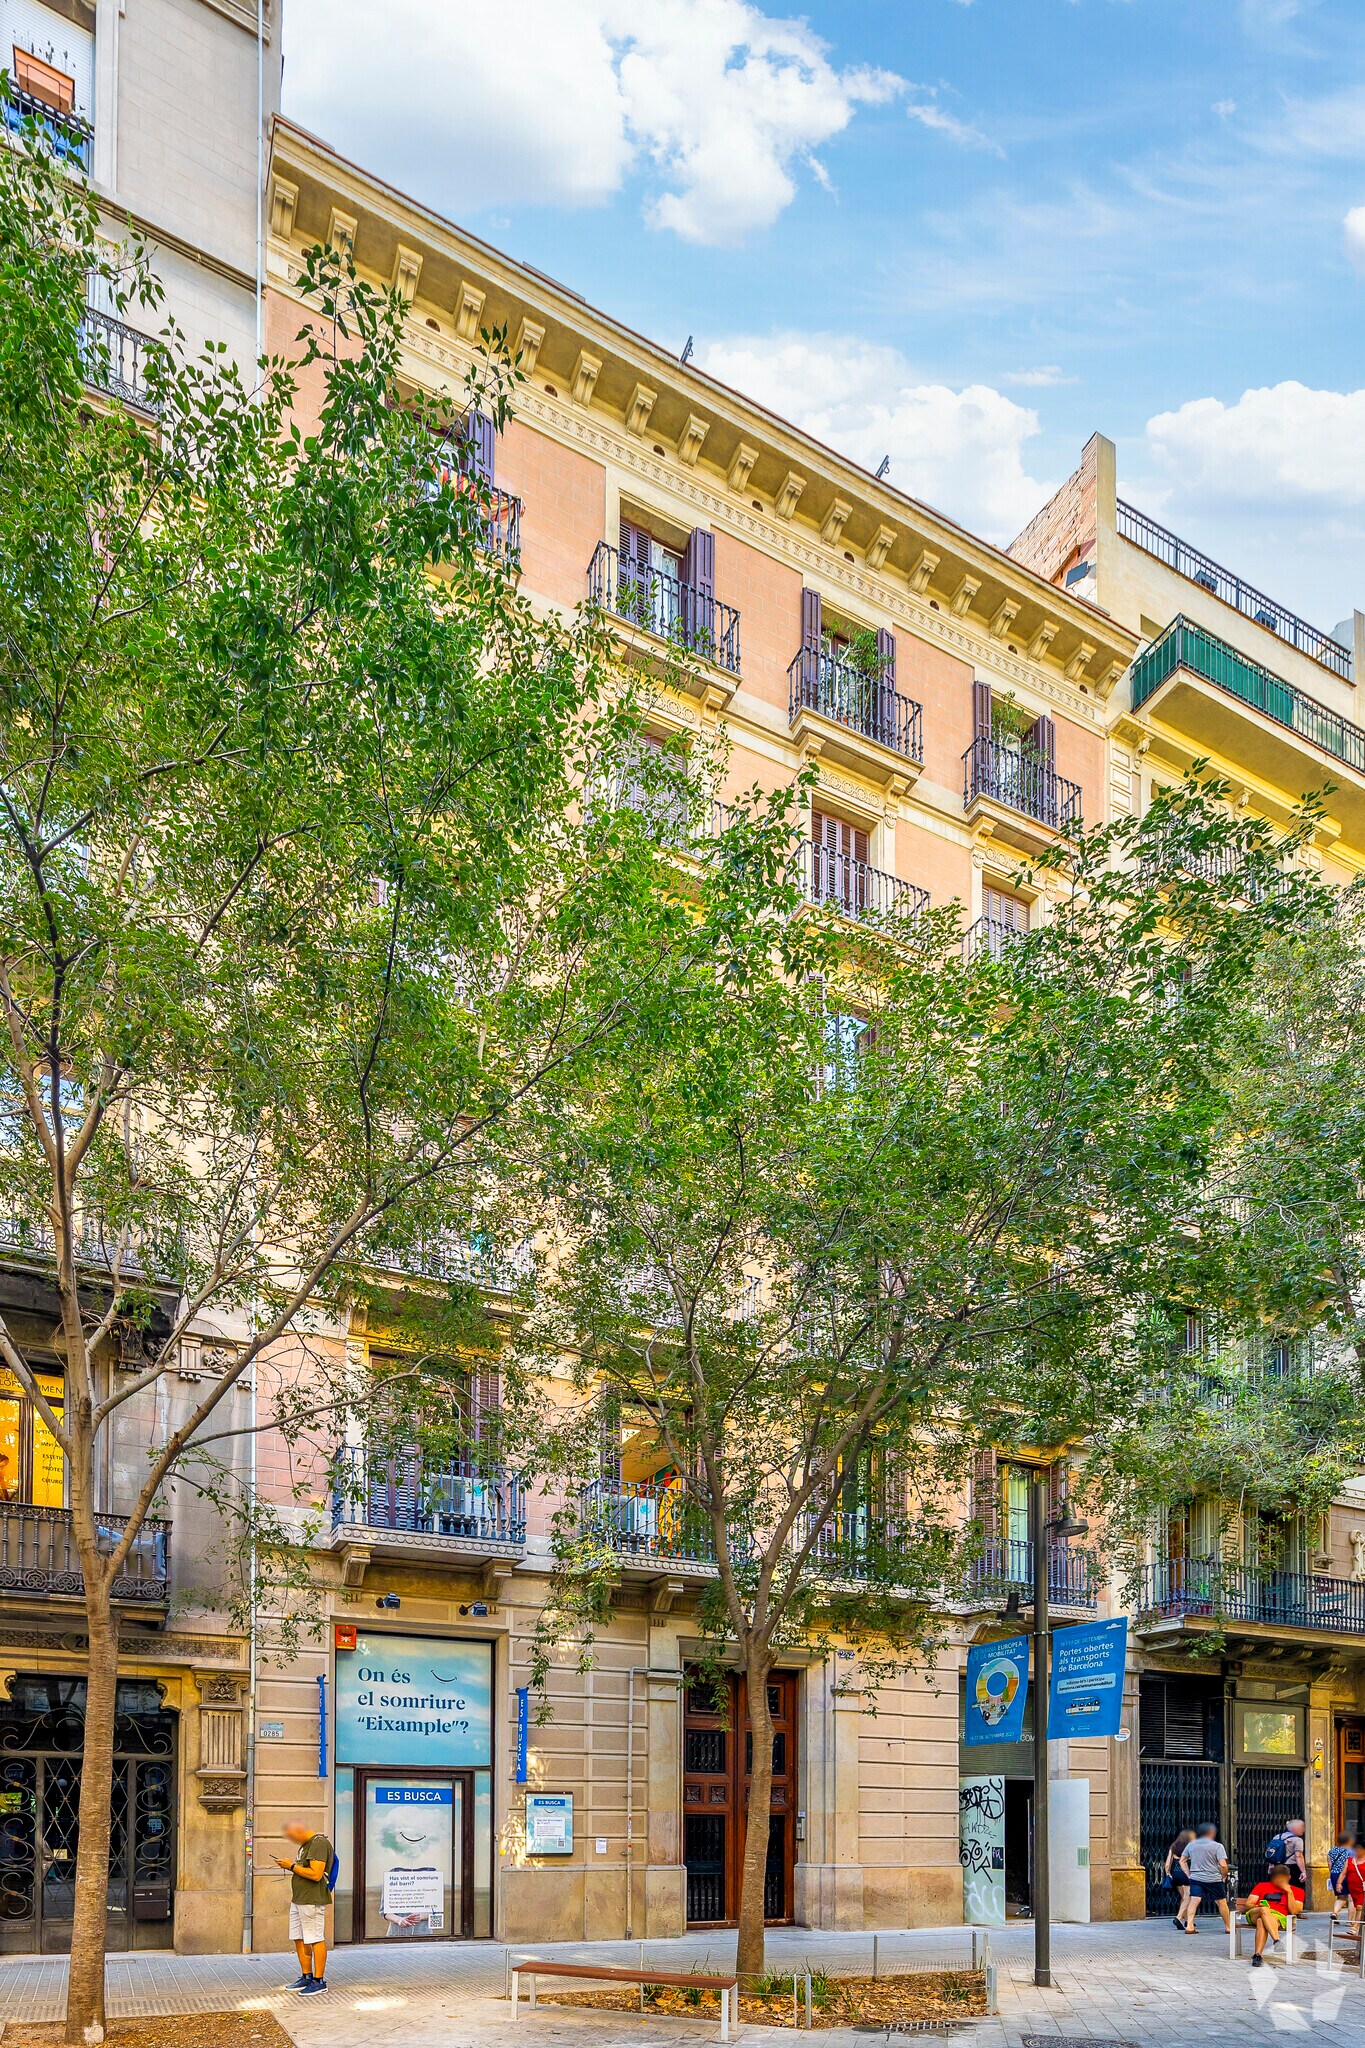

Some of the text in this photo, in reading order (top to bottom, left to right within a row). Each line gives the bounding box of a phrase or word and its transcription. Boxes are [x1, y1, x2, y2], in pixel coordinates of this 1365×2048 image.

[42, 1477, 63, 1485] CIRURG
[1082, 1633, 1108, 1643] SETEMBRE
[997, 1641, 1023, 1651] EUROPEA
[1059, 1643, 1114, 1657] Portes obertes
[987, 1648, 1016, 1658] MOBILITAT
[1058, 1651, 1110, 1665] als transports
[1058, 1660, 1104, 1673] de Barcelona
[357, 1667, 411, 1684] On és
[357, 1690, 466, 1711] el somriure
[387, 1791, 442, 1801] ES BUSCA
